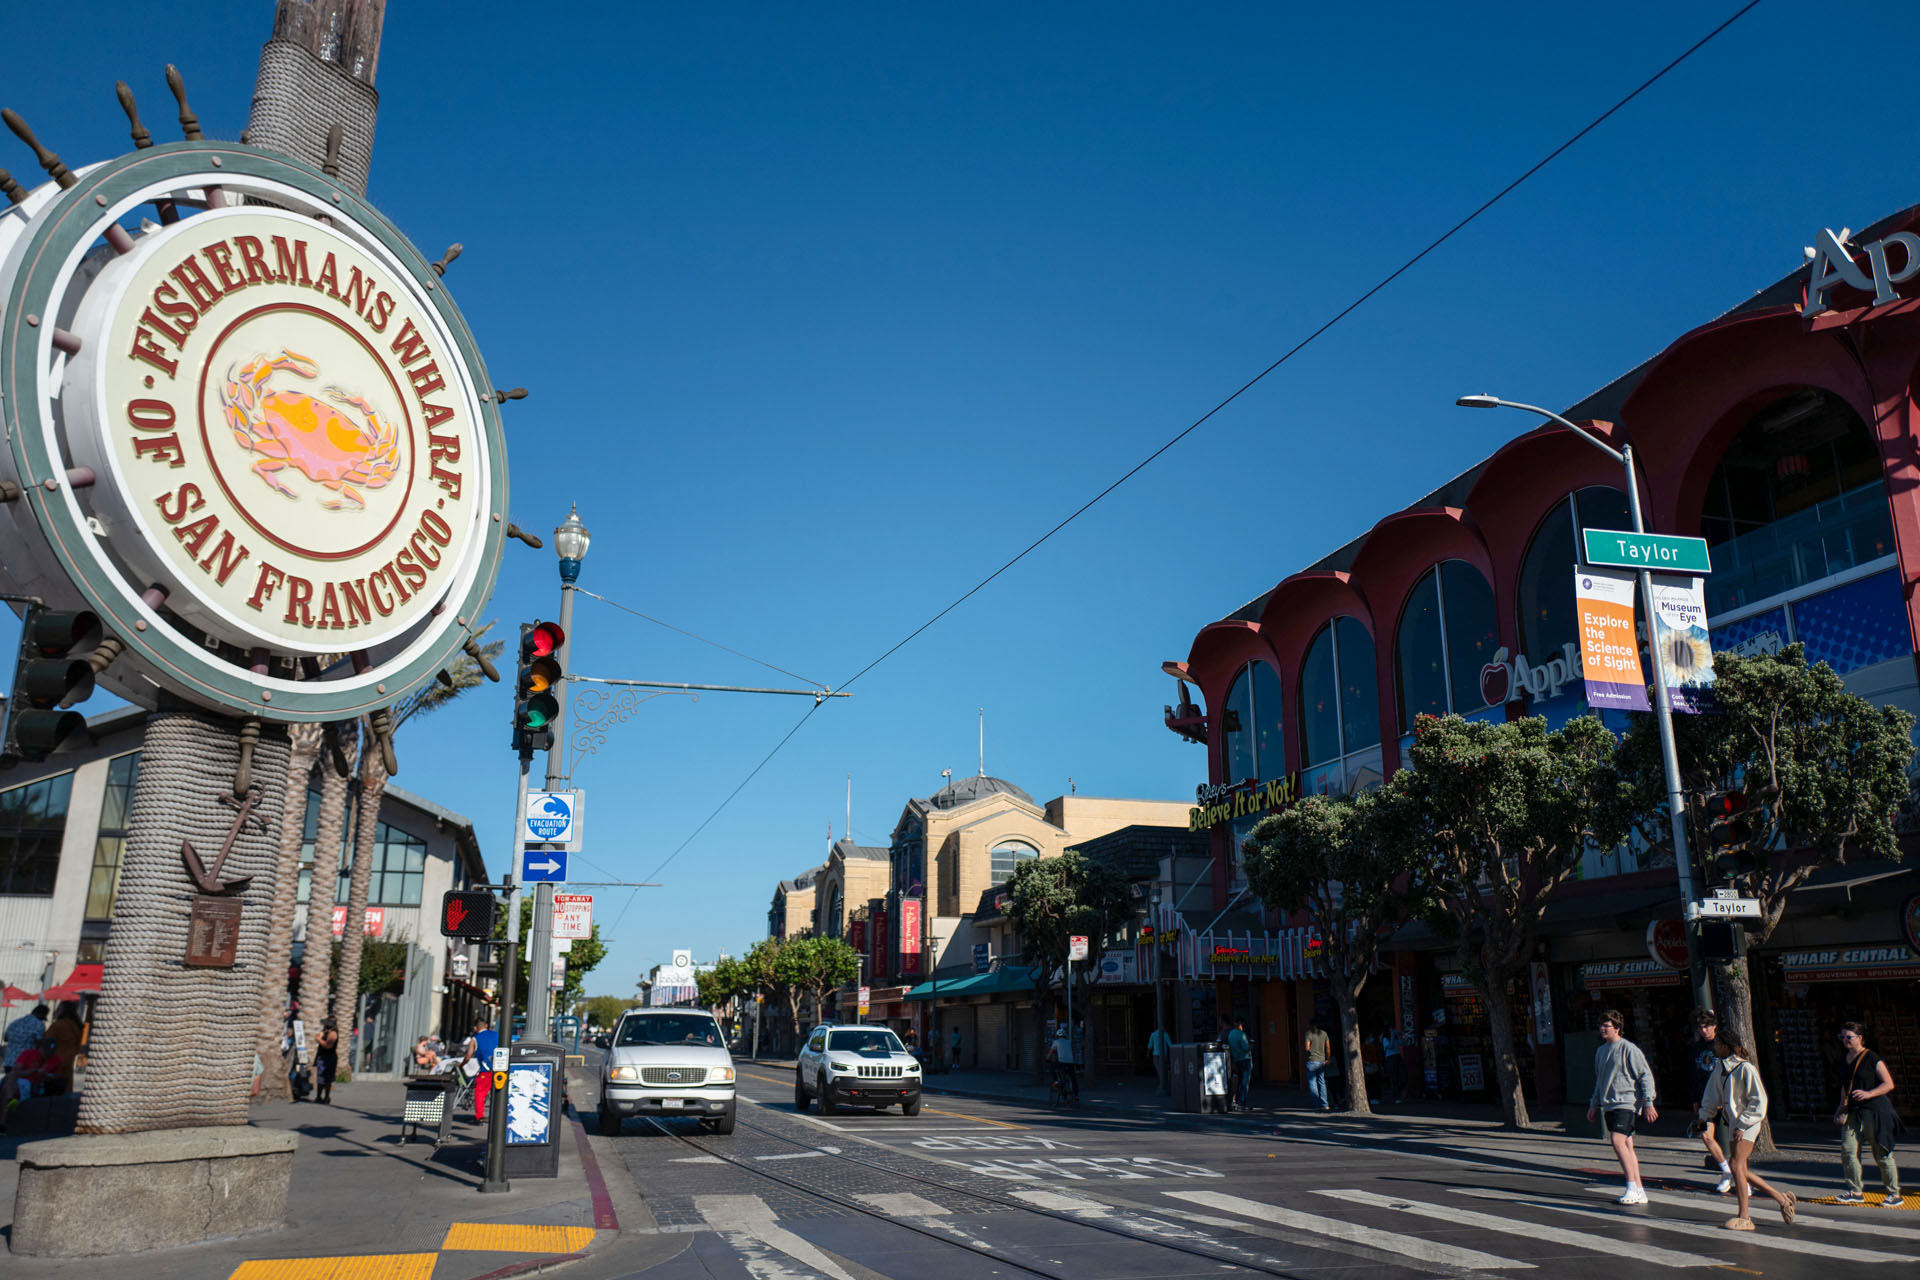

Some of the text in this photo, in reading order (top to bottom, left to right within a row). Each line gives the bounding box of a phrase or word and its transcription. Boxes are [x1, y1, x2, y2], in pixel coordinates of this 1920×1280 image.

[129, 234, 463, 502] FISHERMANS WHARF
[127, 397, 453, 629] OF SAN FRANCISCO
[1617, 540, 1678, 562] Taylor
[1661, 601, 1701, 613] Museum
[1584, 612, 1629, 630] Explore
[1680, 612, 1697, 624] Eye
[1585, 626, 1605, 640] the
[1587, 640, 1633, 656] Science
[1588, 655, 1636, 672] of Sight
[1593, 691, 1632, 700] Free Admission
[1188, 770, 1296, 832] Believe It or Not!
[530, 819, 567, 828] EVACUATION
[538, 827, 557, 836] ROUTE
[557, 895, 591, 903] TOW-AWAY
[553, 903, 591, 914] NO STOPPING
[1712, 902, 1746, 915] Taylor
[562, 922, 582, 931] TIME
[1785, 947, 1911, 966] WHARF CENTRAL
[1585, 962, 1621, 976] WHARF
[1623, 960, 1664, 973] CENTRA
